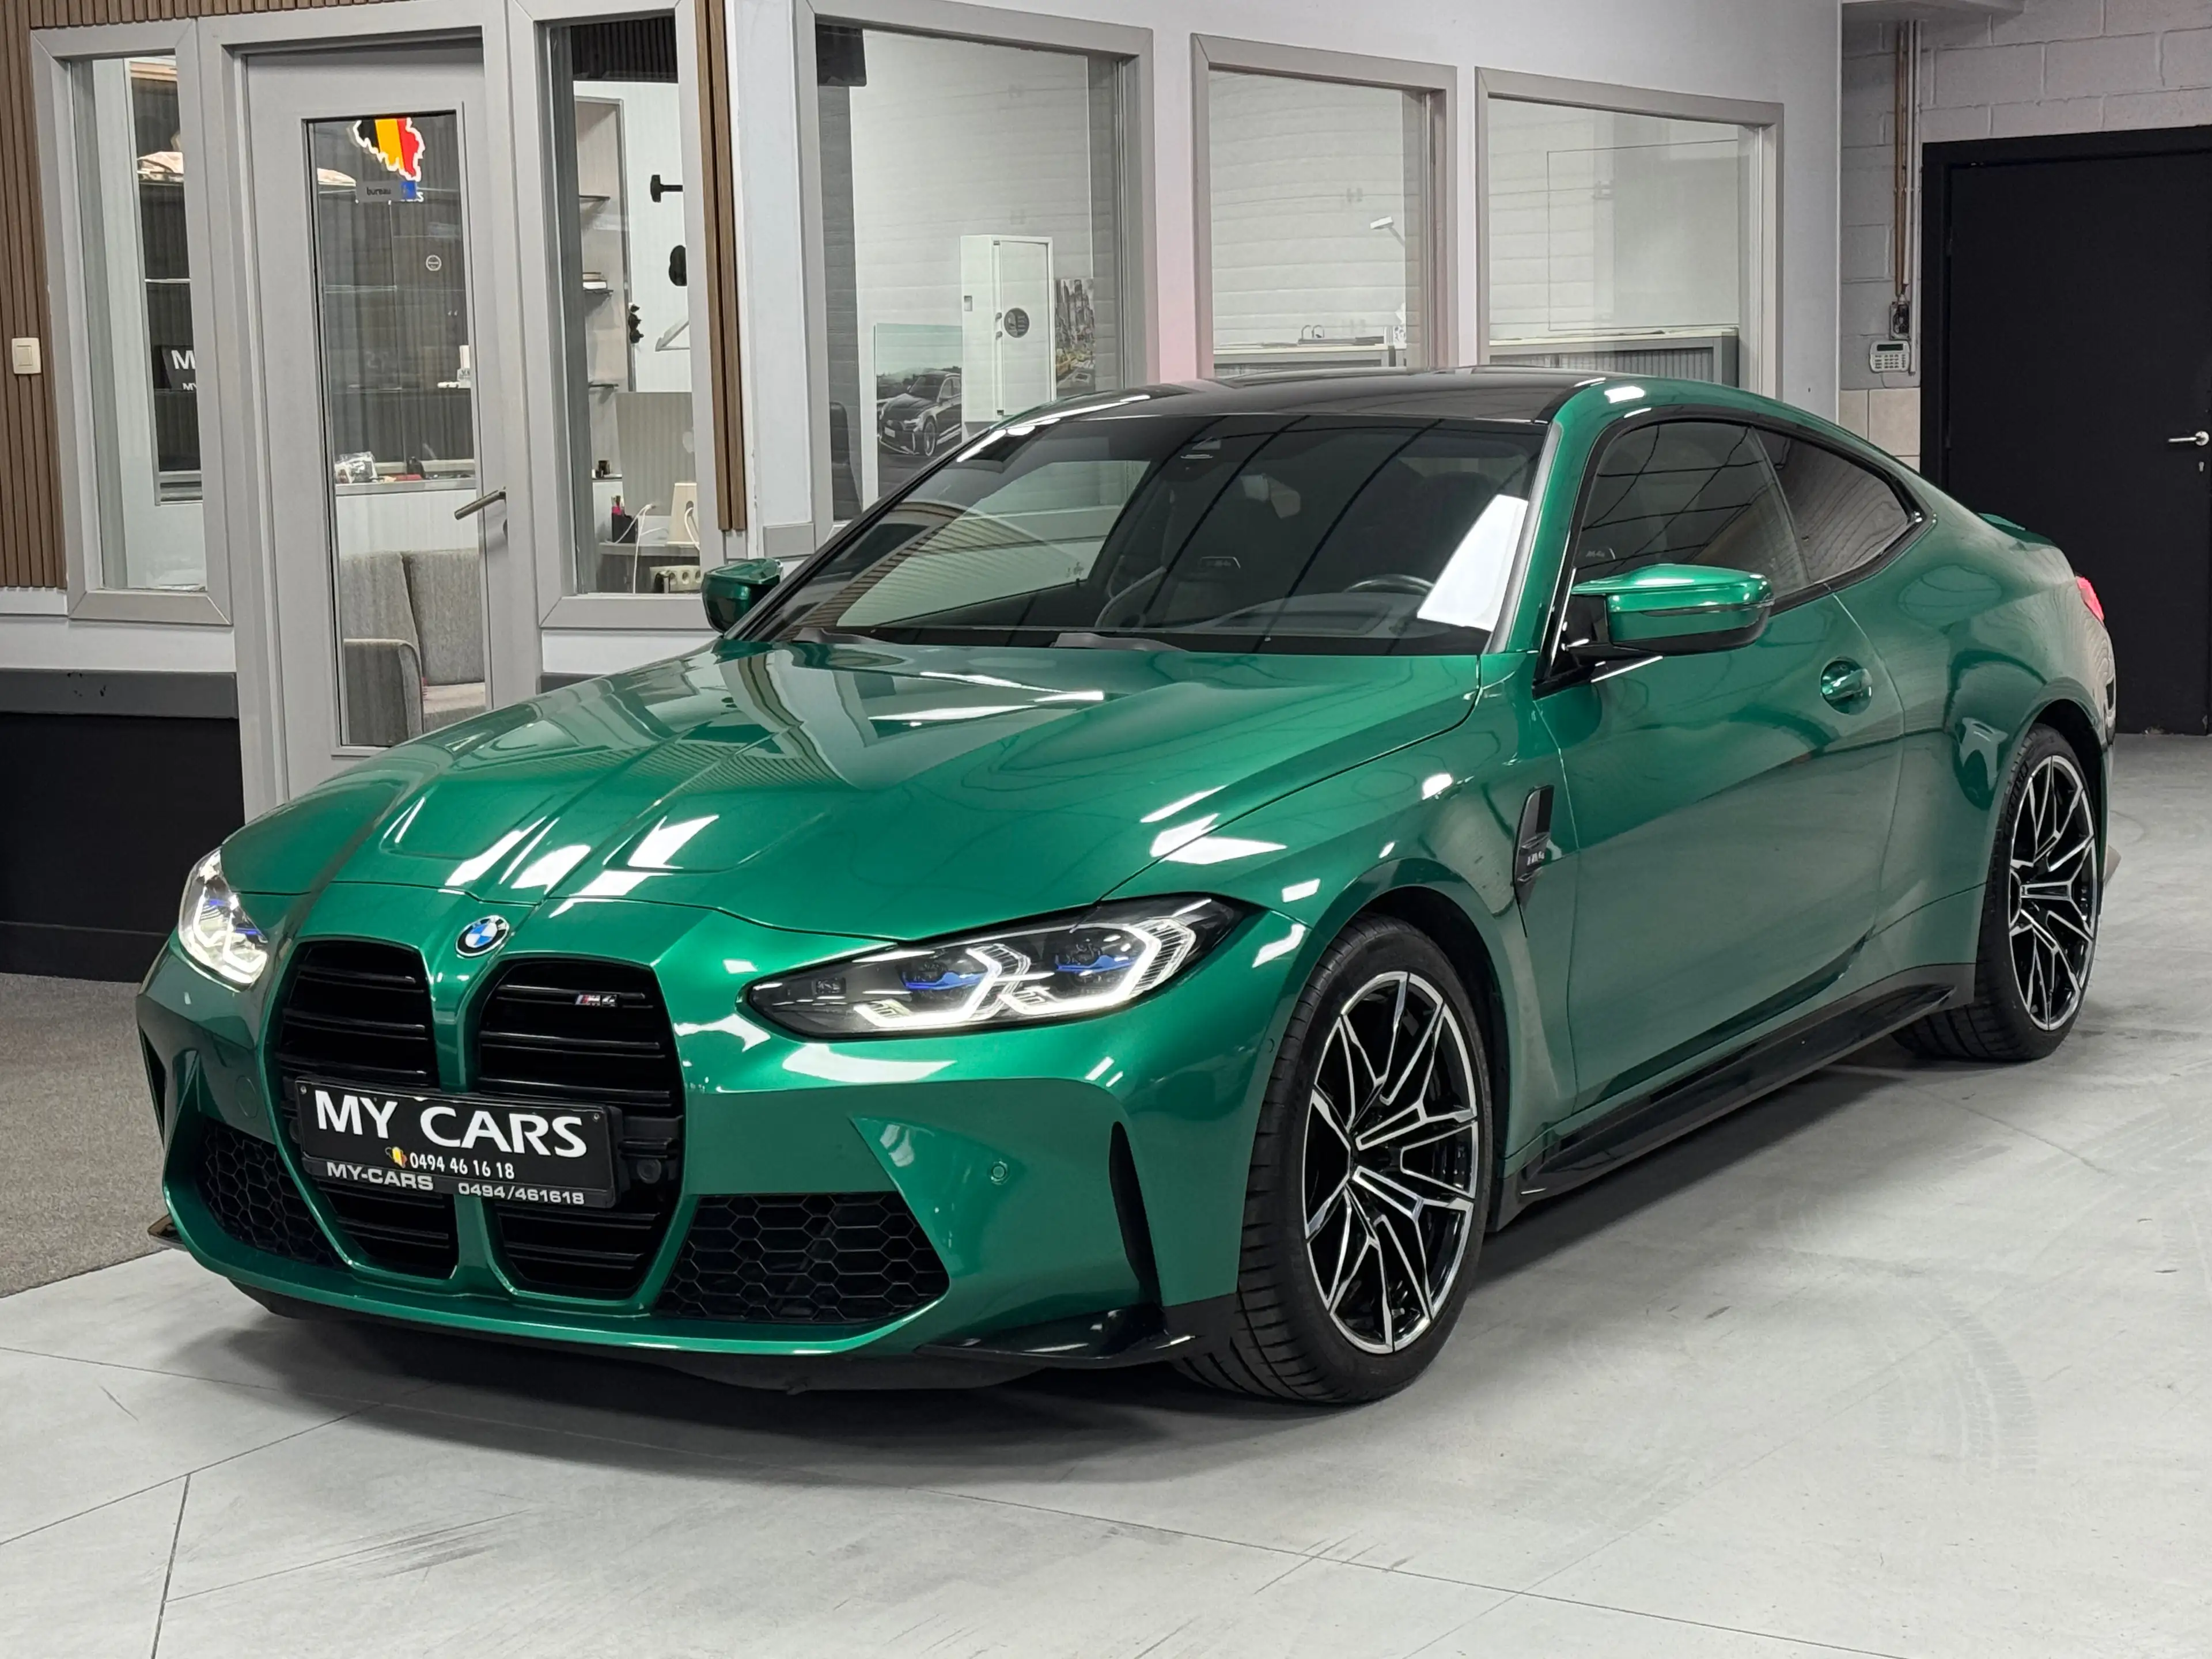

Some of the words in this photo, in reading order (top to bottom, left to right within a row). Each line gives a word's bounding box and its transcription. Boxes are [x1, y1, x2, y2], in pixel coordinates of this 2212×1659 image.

[315, 1090, 397, 1139] MY
[420, 1106, 587, 1158] CARS
[327, 1162, 434, 1191] MY-CARS
[459, 1183, 585, 1205] 0494/461618
[410, 1152, 445, 1172] 0494
[450, 1156, 468, 1175] 46
[473, 1160, 491, 1177] 16
[497, 1162, 514, 1179] 18
